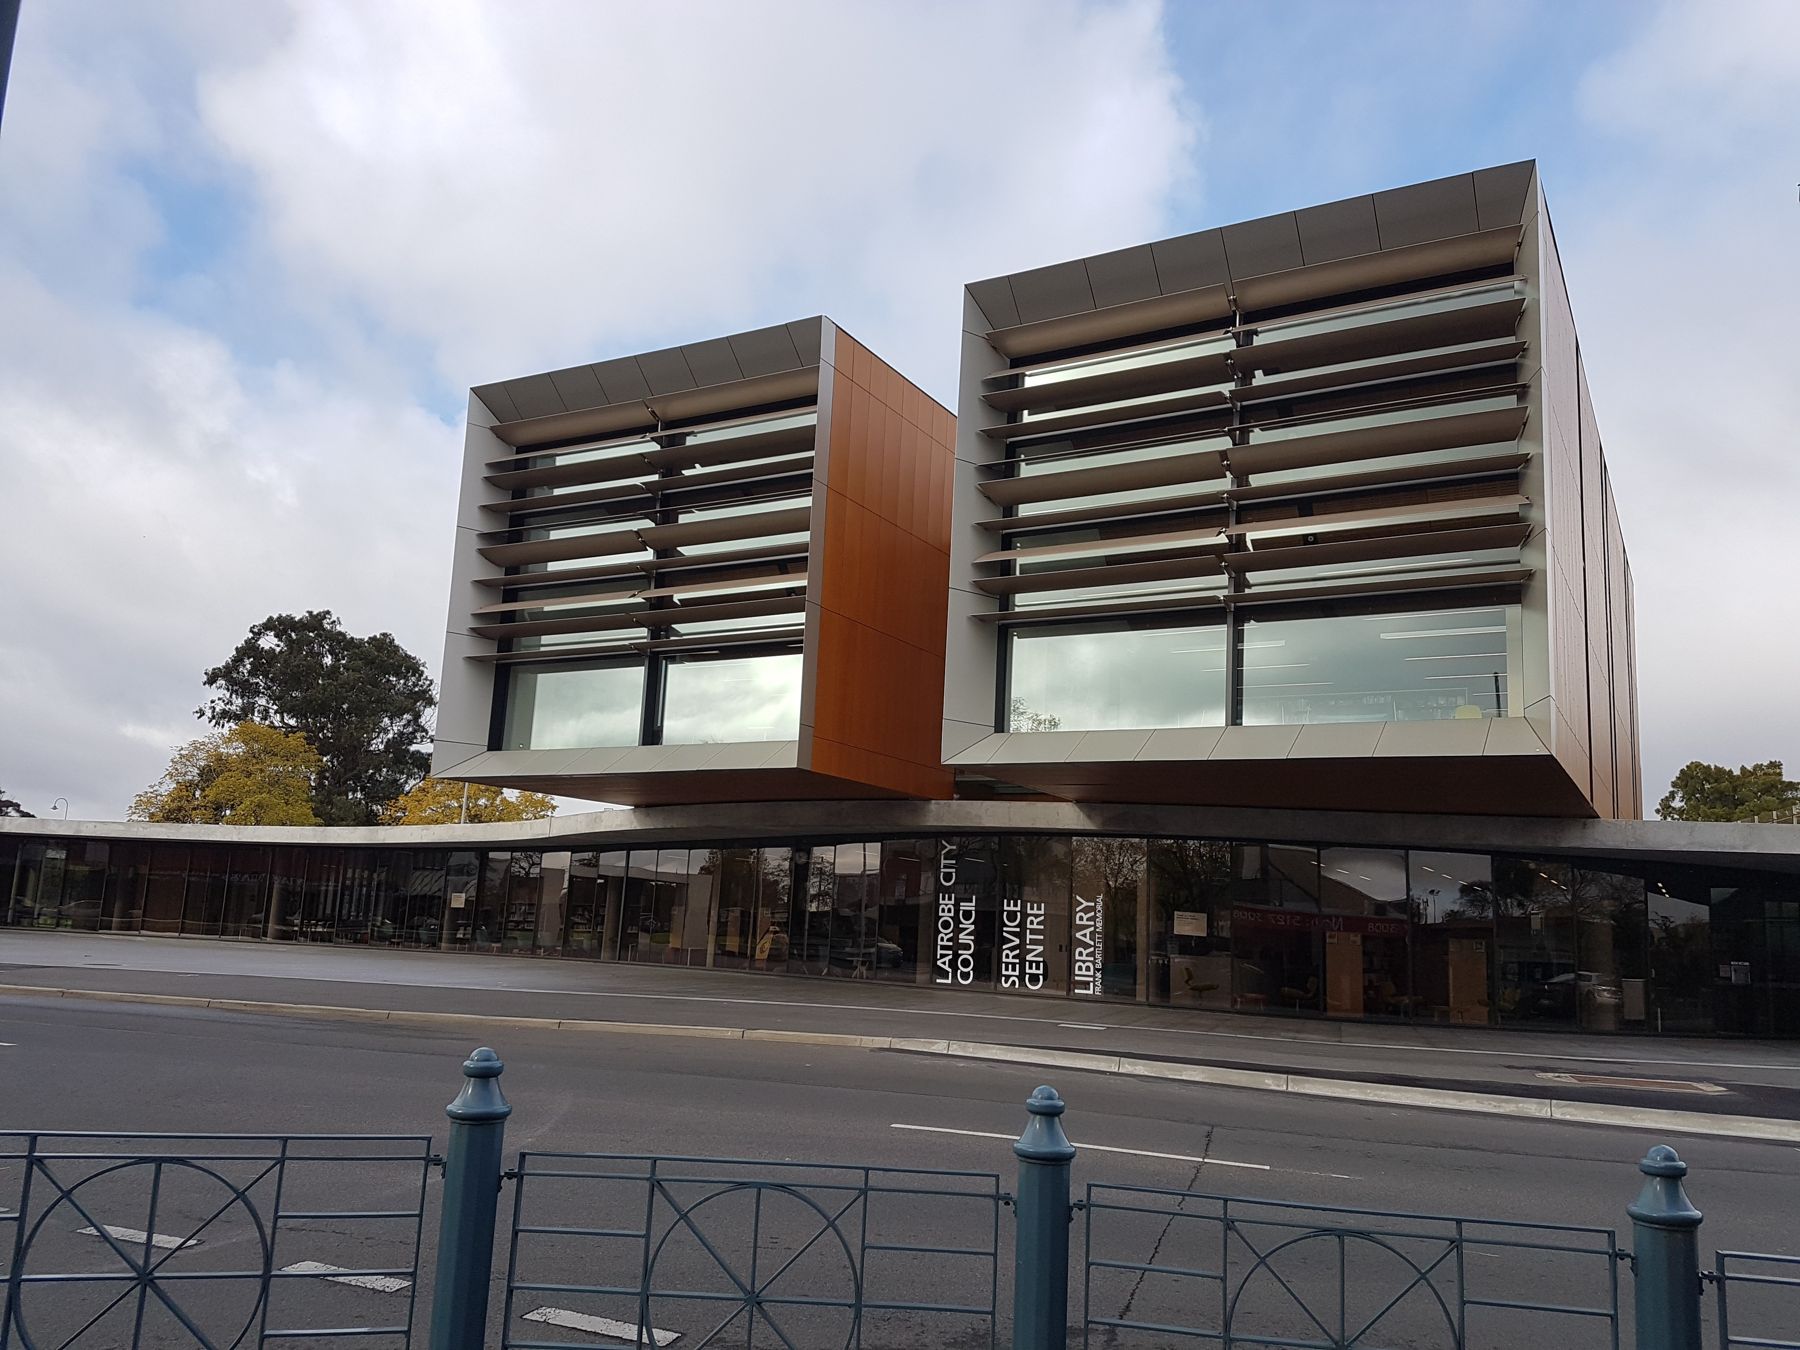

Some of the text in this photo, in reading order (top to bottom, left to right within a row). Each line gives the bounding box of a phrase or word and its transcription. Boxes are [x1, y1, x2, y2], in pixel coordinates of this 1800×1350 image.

[936, 840, 956, 984] LATROBE CITY
[957, 895, 976, 984] COUNCIL
[1001, 899, 1021, 988] SERVICE
[1025, 902, 1045, 990] CENTRE
[1074, 895, 1094, 994] LIBRARY
